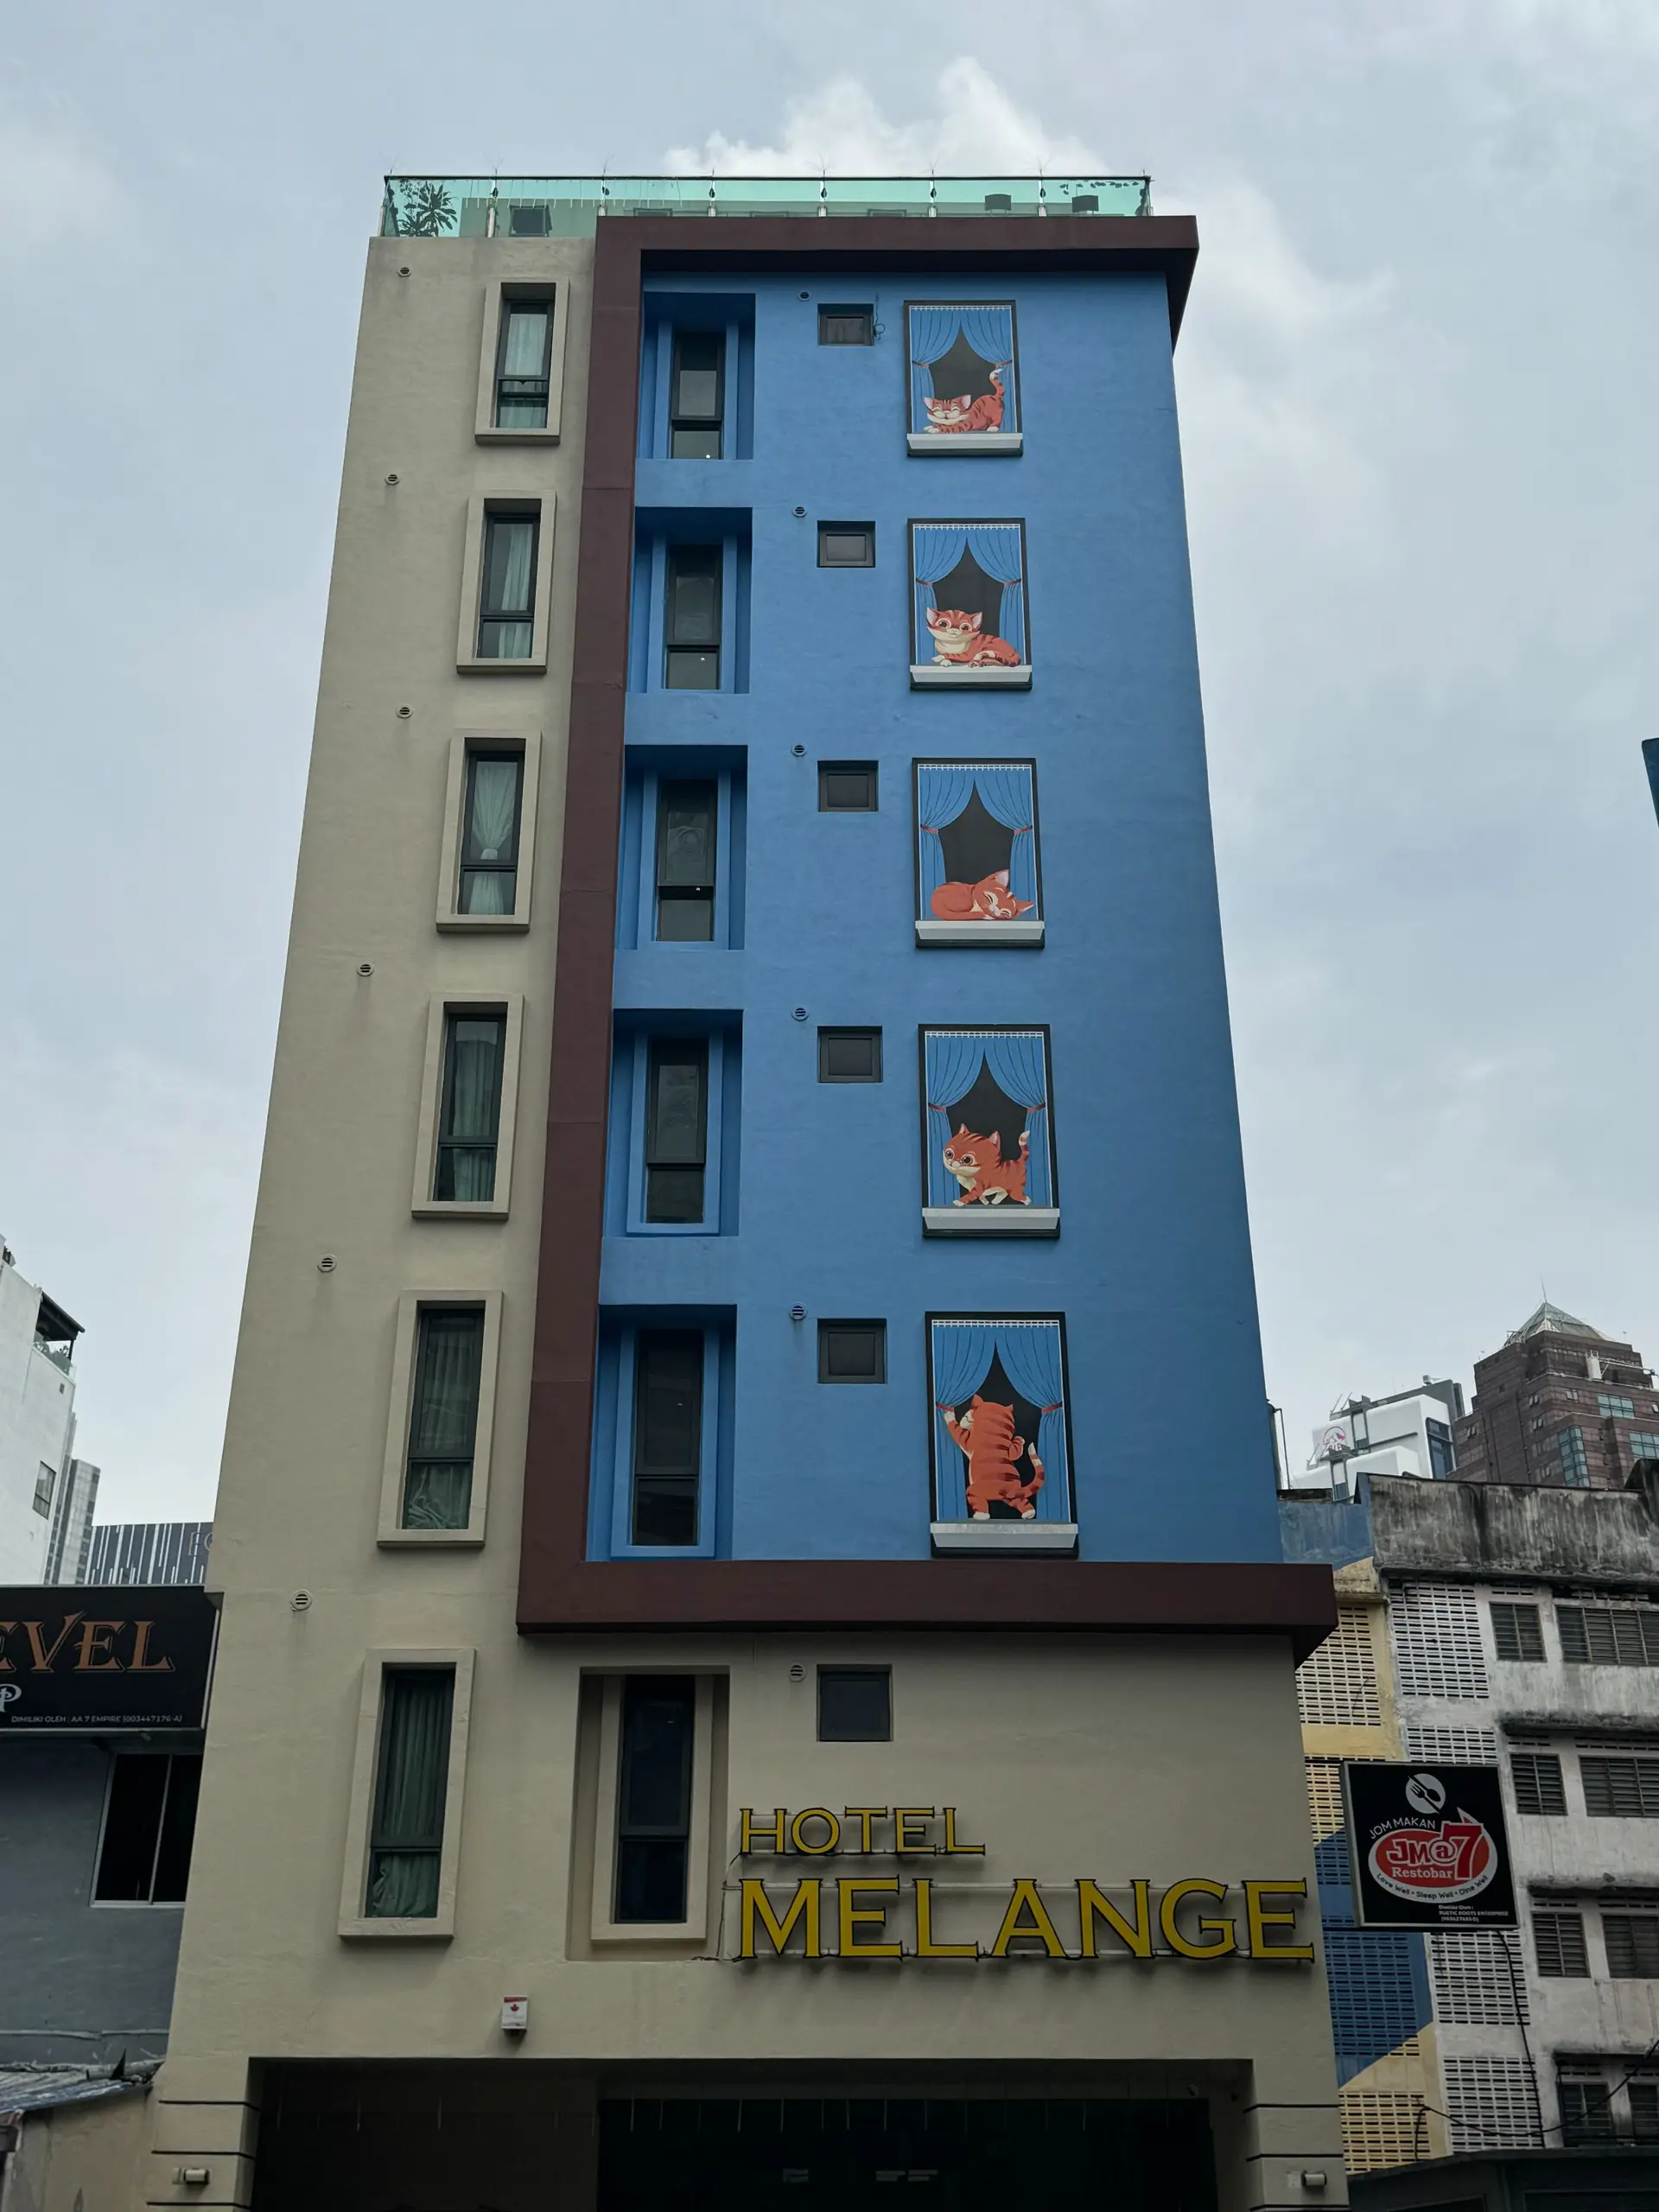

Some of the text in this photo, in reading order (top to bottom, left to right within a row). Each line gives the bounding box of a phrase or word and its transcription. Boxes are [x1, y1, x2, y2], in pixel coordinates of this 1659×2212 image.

[741, 1807, 985, 1855] HOTEL
[1369, 1817, 1435, 1839] JOM MAKAN
[1376, 1872, 1489, 1900] Love Well Sleep Well Dine Well
[1391, 1866, 1452, 1878] Restobar
[739, 1875, 1314, 1963] MELANGE
